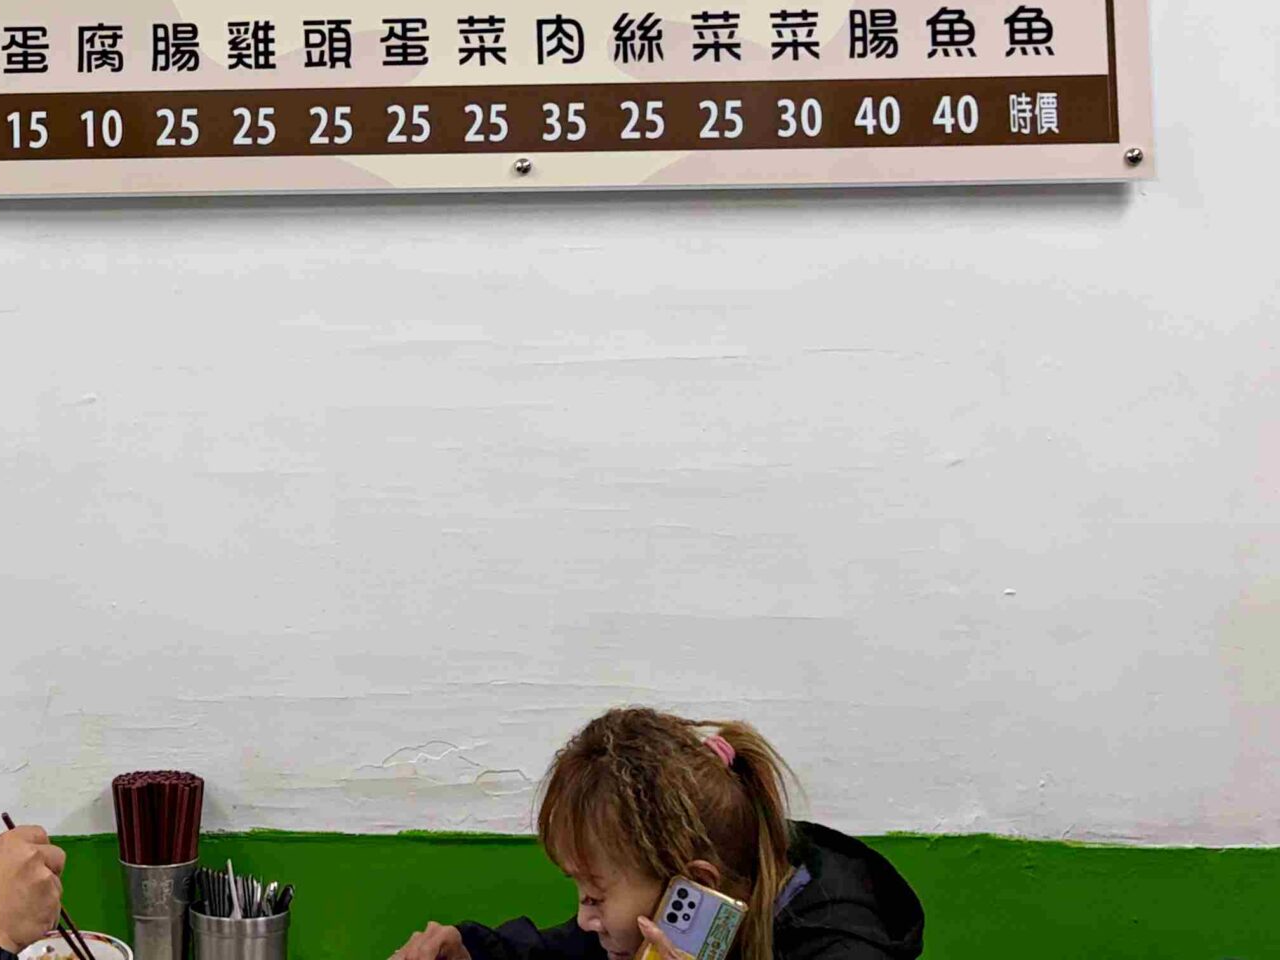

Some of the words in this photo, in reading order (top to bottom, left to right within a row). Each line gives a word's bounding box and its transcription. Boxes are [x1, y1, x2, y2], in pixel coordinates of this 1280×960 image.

[8, 112, 47, 148] 15
[81, 110, 122, 146] 10
[157, 109, 198, 145] 25
[234, 108, 275, 144] 25
[310, 107, 352, 143] 25
[388, 105, 430, 142] 25
[465, 104, 507, 141] 25
[543, 103, 585, 140] 35
[621, 101, 664, 138] 25
[700, 101, 742, 138] 25
[778, 99, 821, 137] 30
[855, 97, 899, 134] 40
[933, 95, 978, 133] 40
[1010, 93, 1058, 133] 時價
